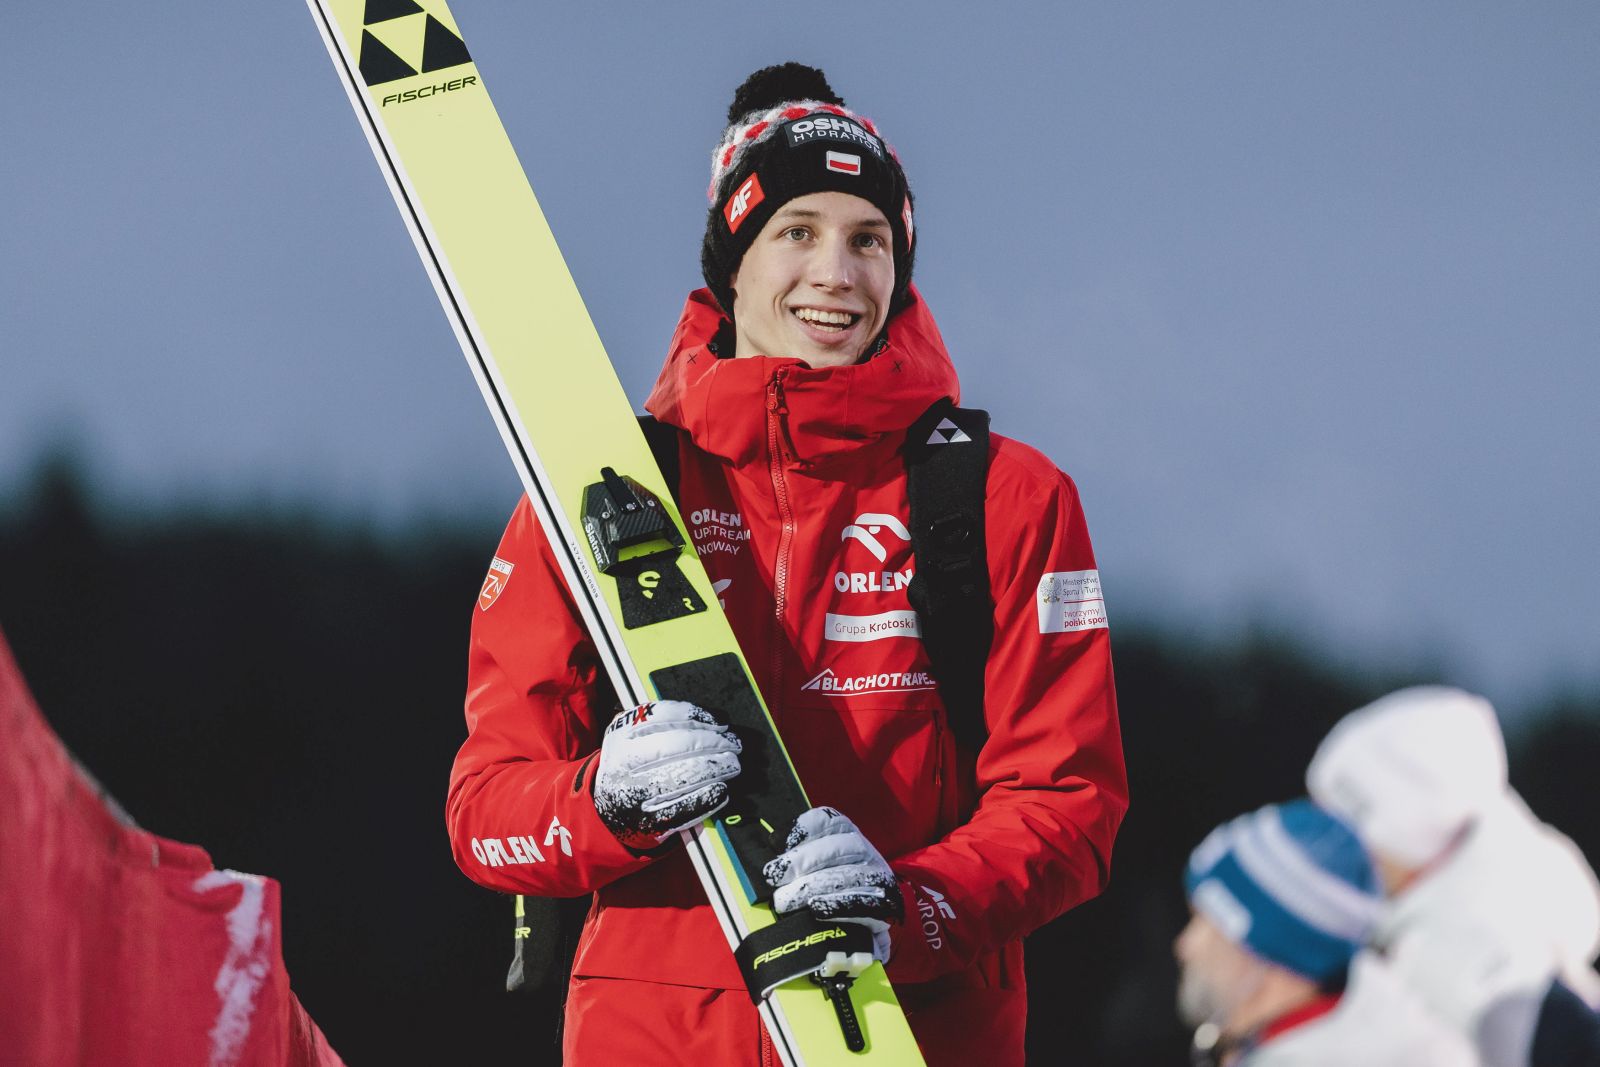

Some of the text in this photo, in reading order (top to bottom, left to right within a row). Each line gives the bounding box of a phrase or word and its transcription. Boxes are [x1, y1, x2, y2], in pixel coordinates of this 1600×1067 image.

[382, 75, 477, 107] FISCHER
[791, 118, 881, 150] OSHEE
[793, 129, 882, 157] HYDRATION
[690, 508, 742, 527] ORLEN
[585, 522, 604, 565] Slatnar
[834, 568, 914, 594] ORLEN
[834, 617, 915, 635] Grupa Krotoski
[1064, 617, 1086, 628] polski
[471, 835, 546, 867] ORLEN
[753, 928, 836, 970] FISCHER
